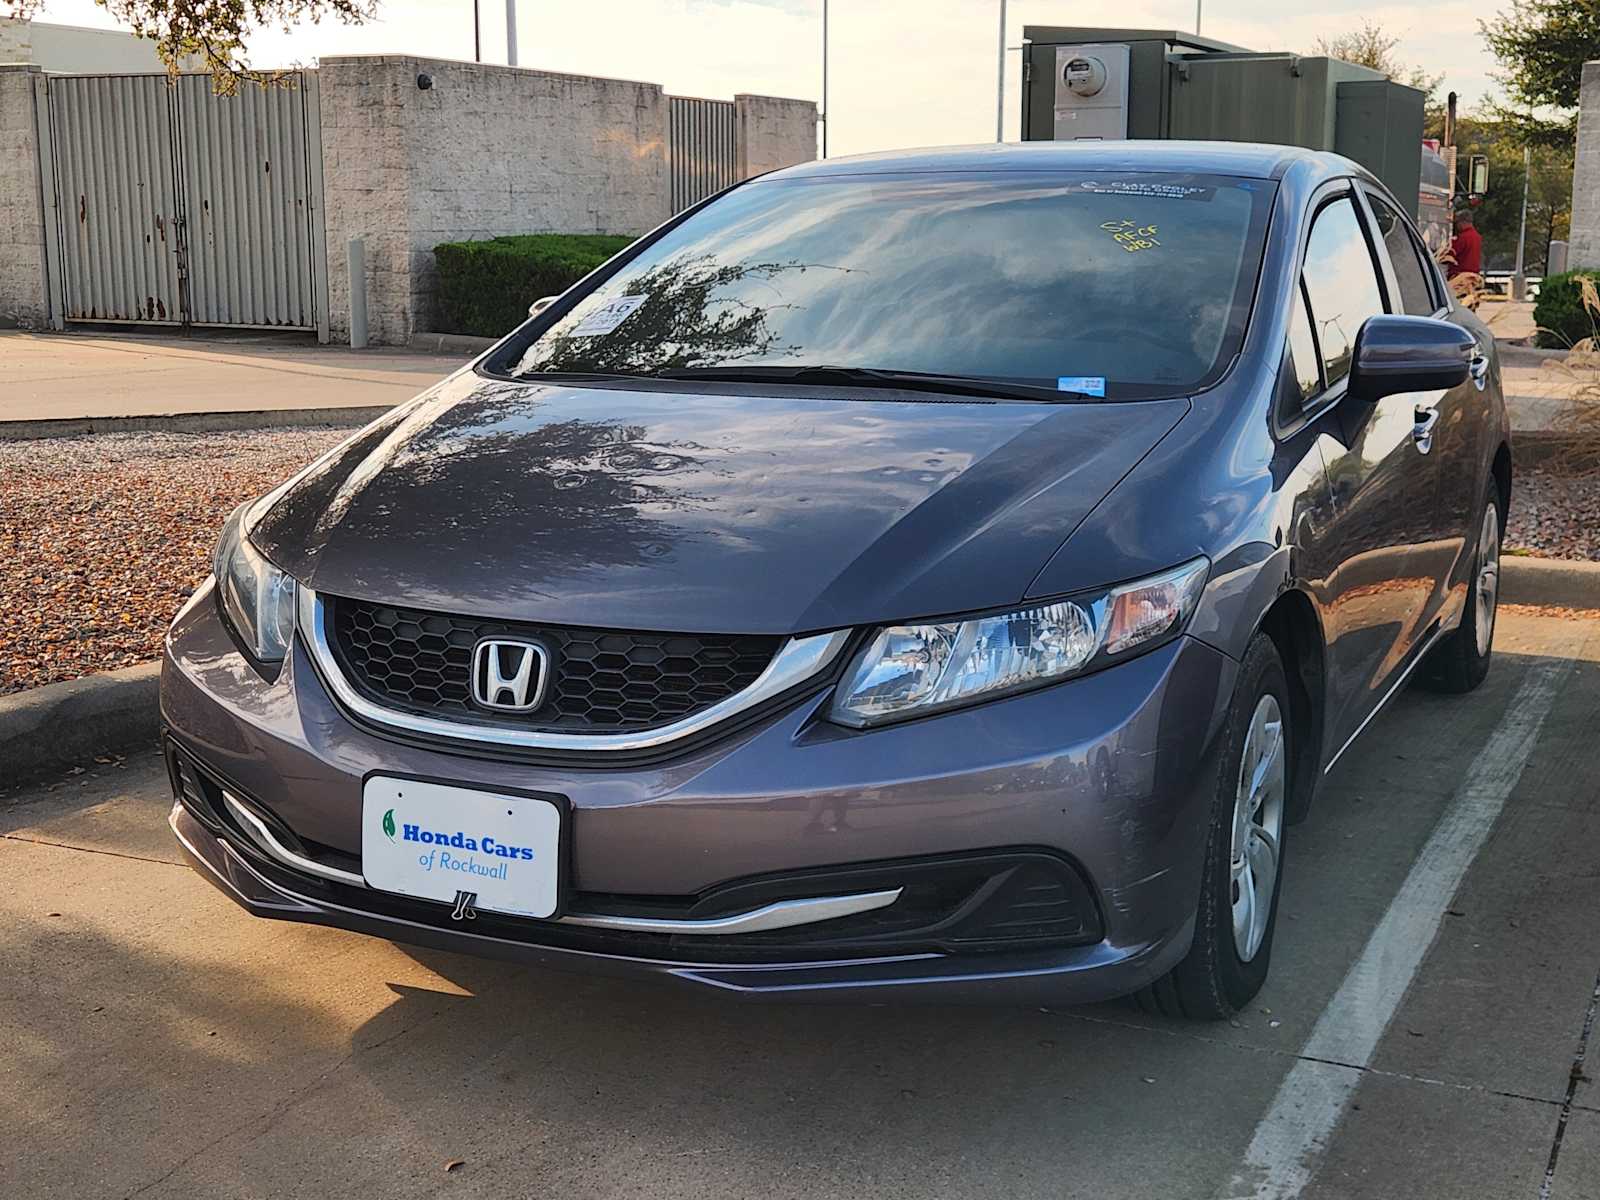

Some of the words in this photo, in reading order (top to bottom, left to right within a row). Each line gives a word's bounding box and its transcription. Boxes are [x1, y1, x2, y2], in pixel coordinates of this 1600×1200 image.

[485, 642, 535, 706] H
[403, 824, 478, 851] Honda
[481, 837, 534, 861] Cars
[419, 850, 436, 871] of
[439, 851, 508, 881] Rockwall
